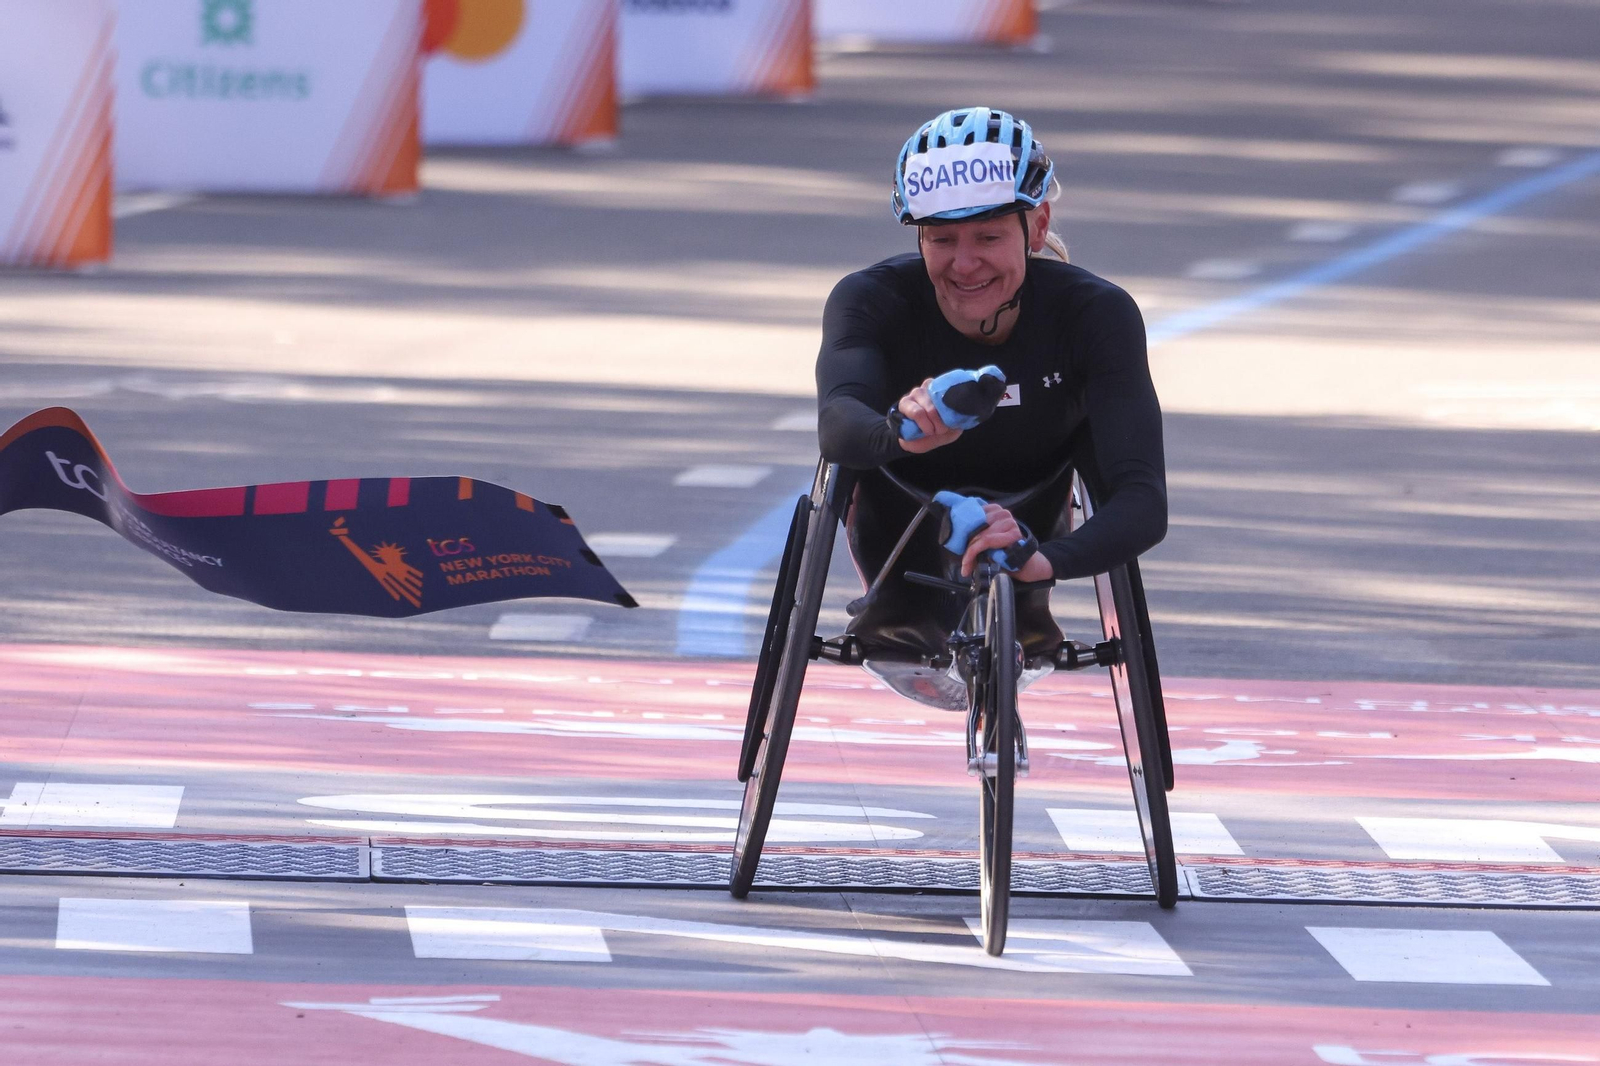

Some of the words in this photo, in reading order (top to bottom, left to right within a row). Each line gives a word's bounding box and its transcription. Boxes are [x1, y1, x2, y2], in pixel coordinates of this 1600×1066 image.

[907, 158, 1012, 197] SCARONI
[426, 537, 475, 556] tcs
[439, 556, 483, 573] NEW
[486, 553, 534, 565] YORK
[536, 555, 572, 568] CITY
[446, 566, 551, 585] MARATHON
